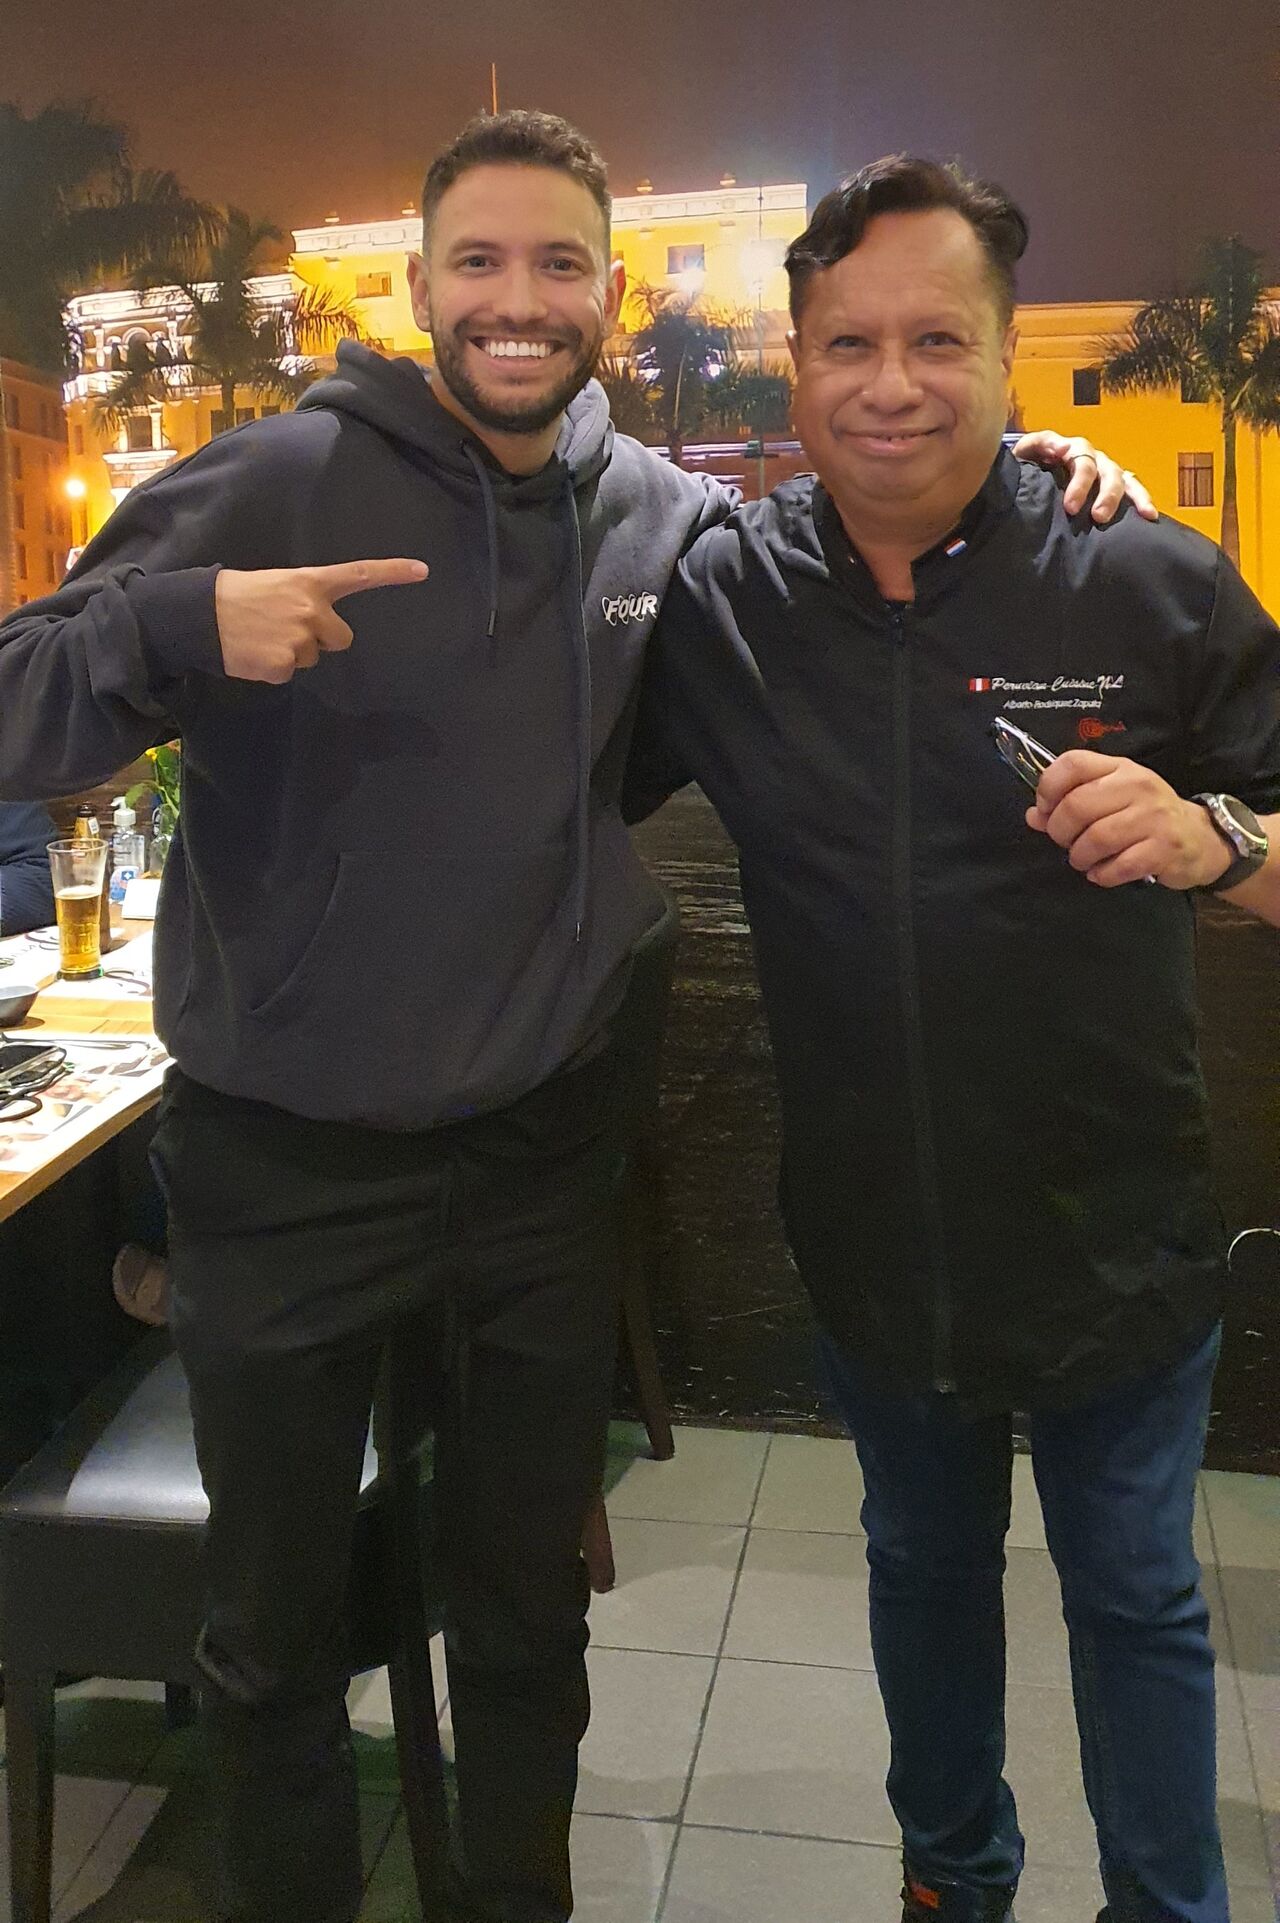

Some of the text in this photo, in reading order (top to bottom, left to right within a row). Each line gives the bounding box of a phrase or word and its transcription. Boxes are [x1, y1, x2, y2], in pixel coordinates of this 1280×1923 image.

[602, 591, 659, 626] FOUR
[991, 677, 1048, 691] Peruvian
[1051, 676, 1096, 691] Cuisine
